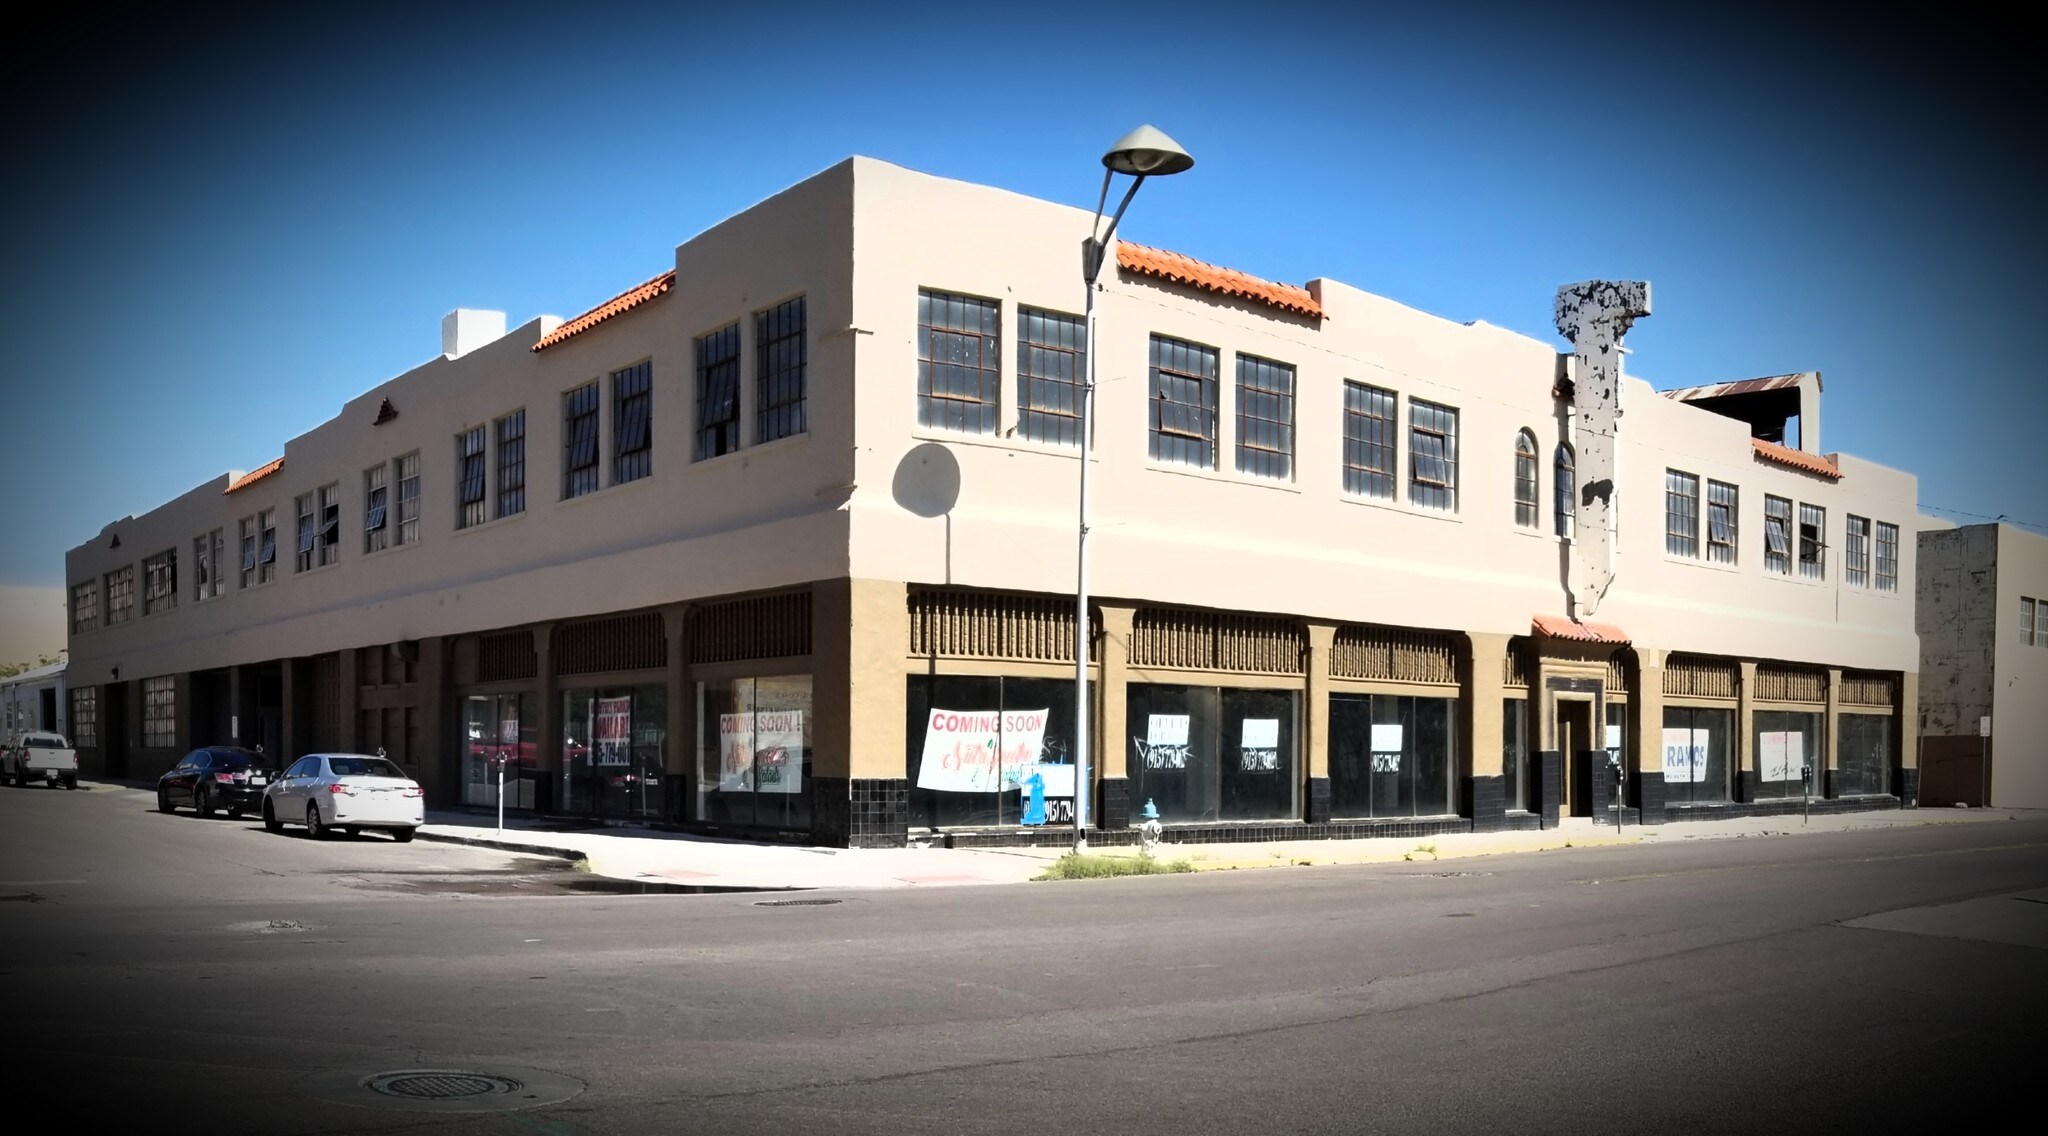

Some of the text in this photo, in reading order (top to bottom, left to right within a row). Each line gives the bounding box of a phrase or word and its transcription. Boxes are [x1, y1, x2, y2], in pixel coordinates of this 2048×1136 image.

[760, 715, 792, 733] SOON
[932, 713, 1043, 733] COMING SOON
